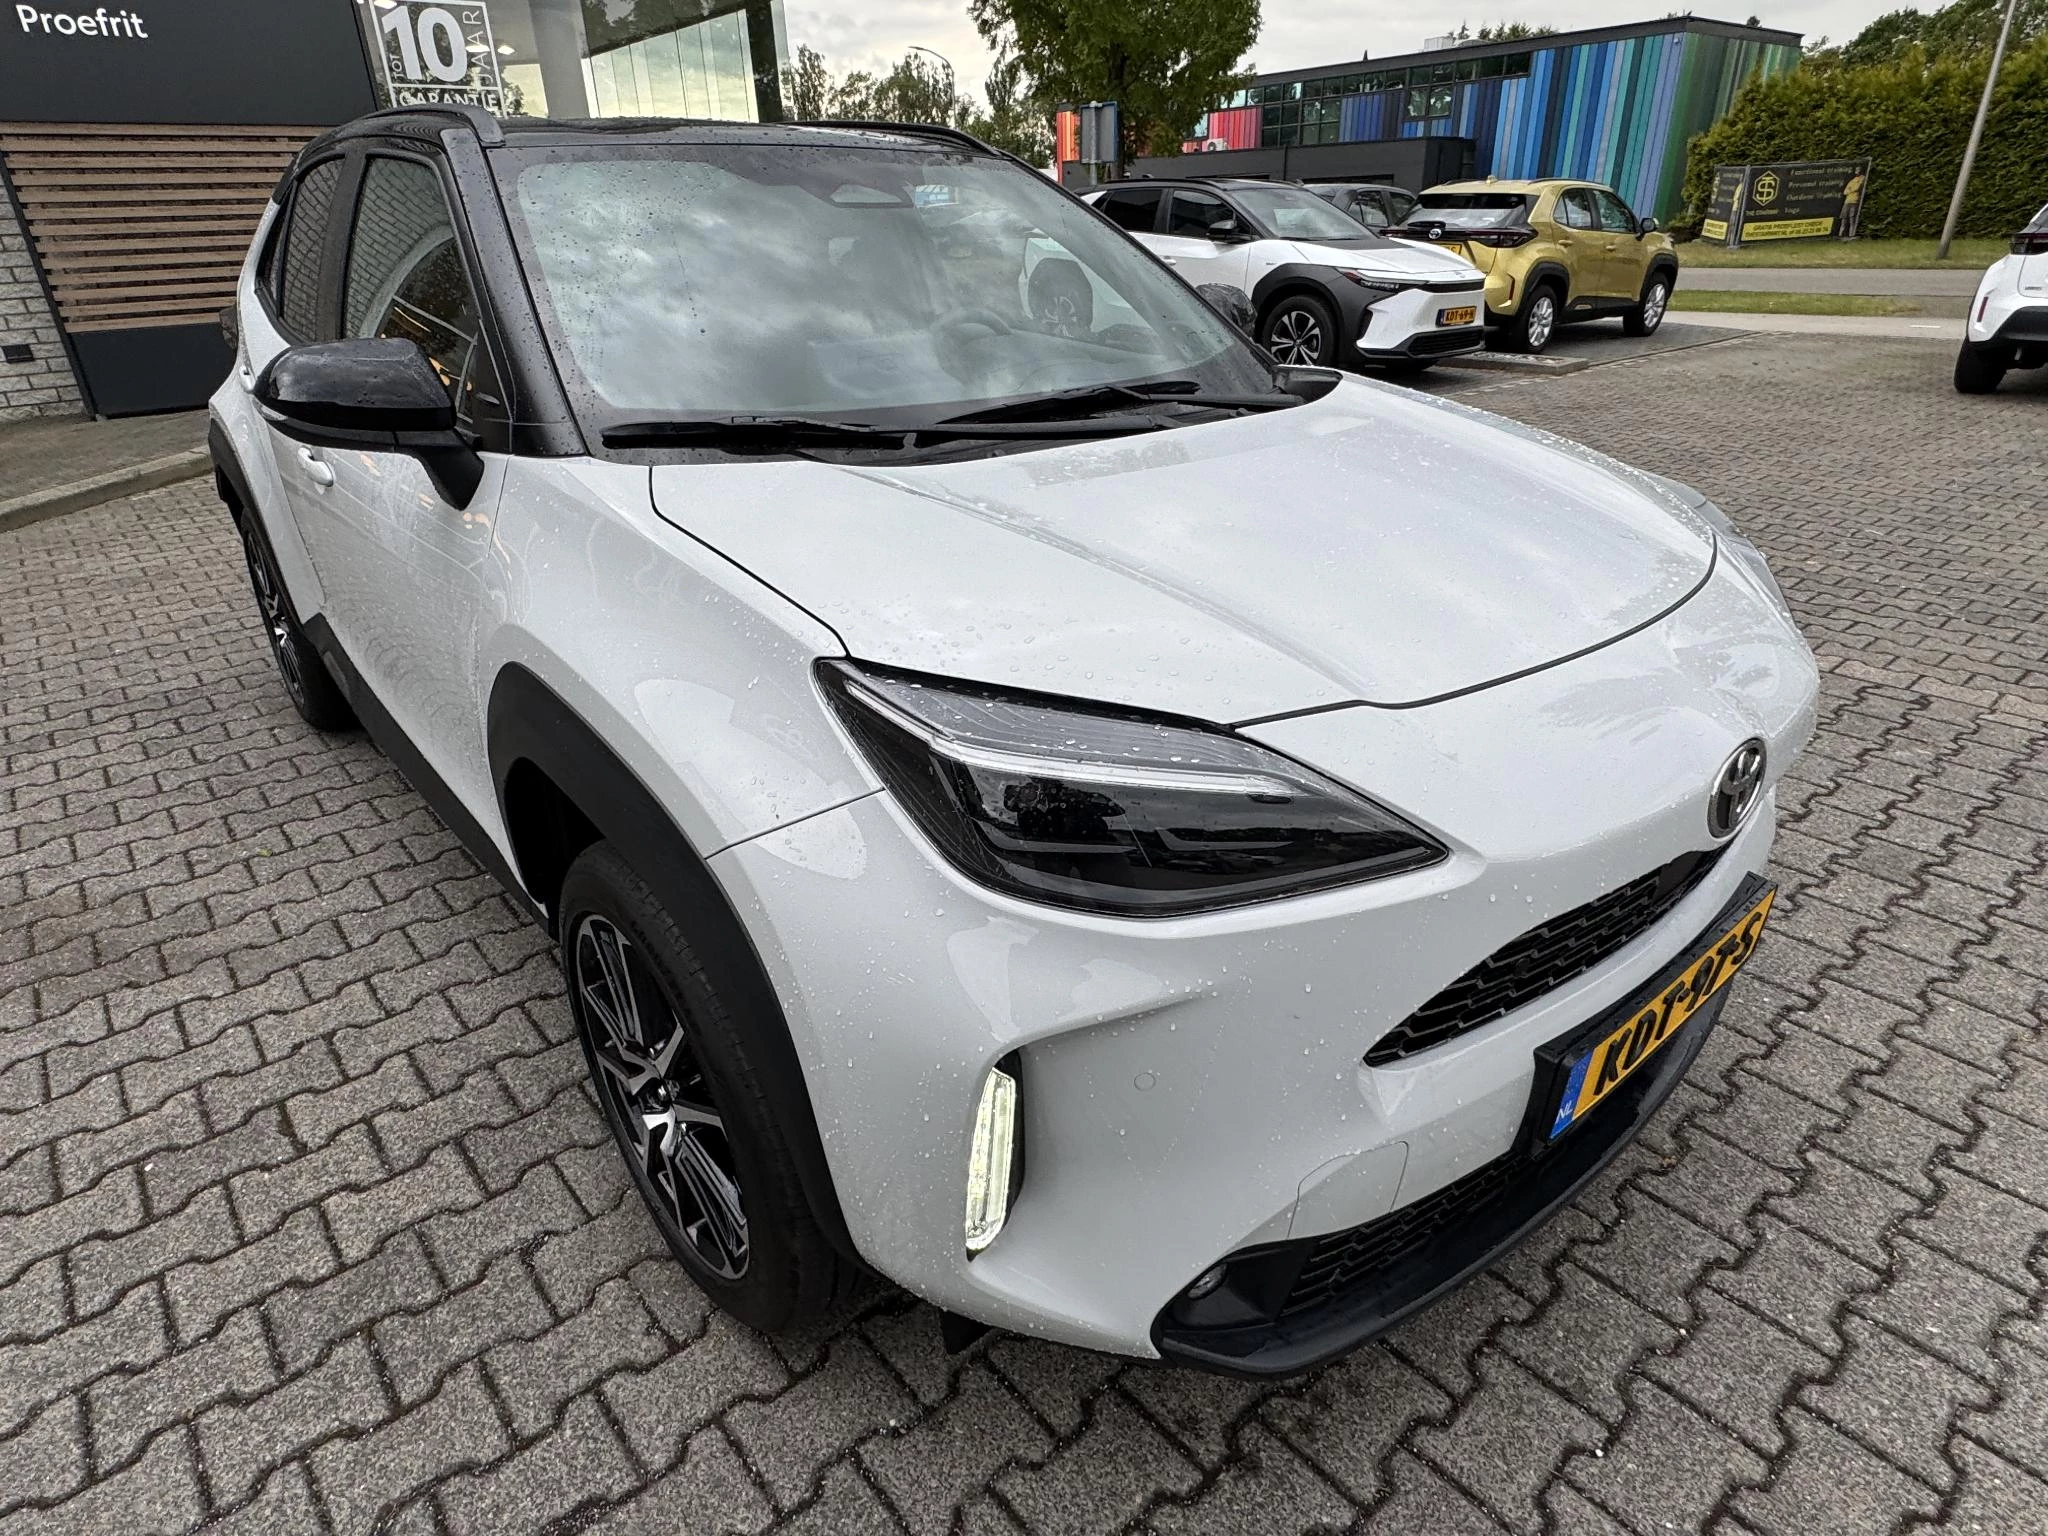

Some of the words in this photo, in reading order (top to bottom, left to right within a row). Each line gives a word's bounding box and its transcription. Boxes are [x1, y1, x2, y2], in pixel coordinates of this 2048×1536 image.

[15, 4, 149, 39] Proefrit
[381, 5, 468, 82] 10
[462, 10, 495, 85] JAAR
[389, 53, 405, 80] TOT
[1556, 1100, 1573, 1121] NL
